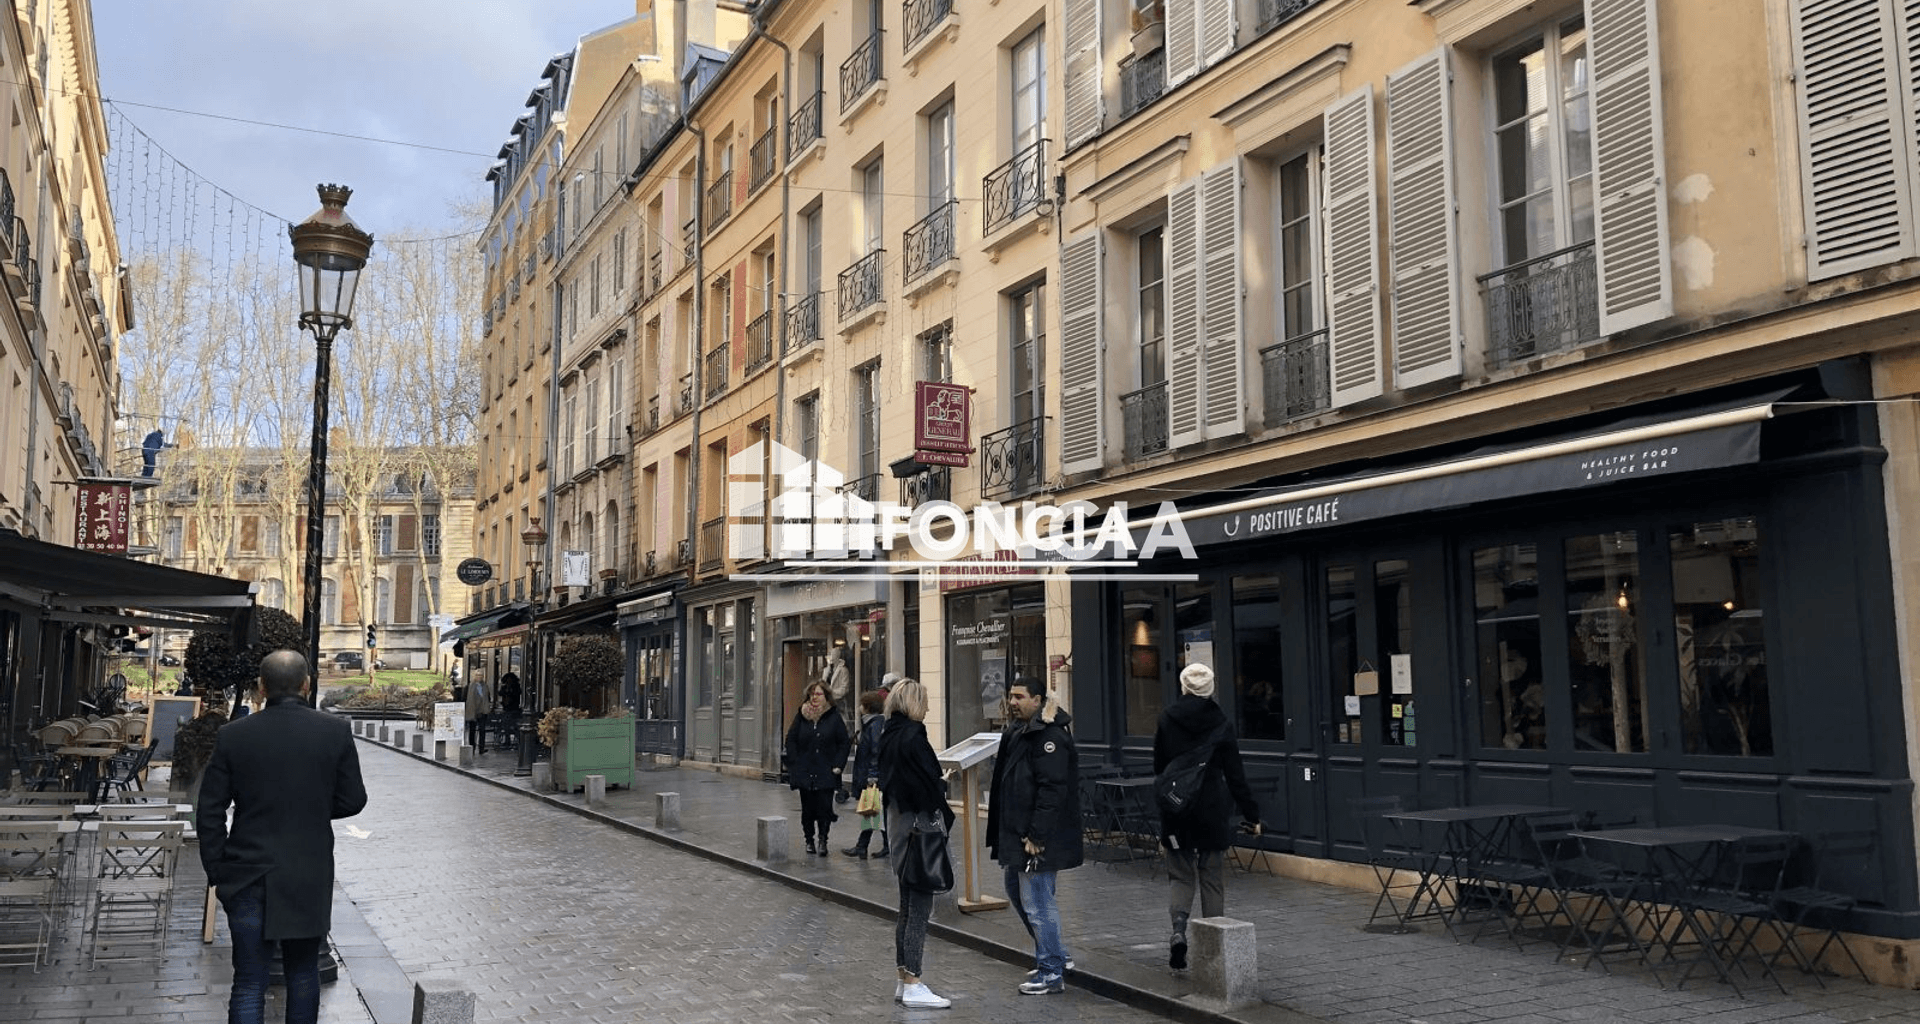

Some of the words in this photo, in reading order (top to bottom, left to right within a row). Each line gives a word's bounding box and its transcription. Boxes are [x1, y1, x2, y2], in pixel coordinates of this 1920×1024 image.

[1581, 454, 1635, 470] HEALTHY
[1643, 447, 1678, 459] FOOD
[1586, 472, 1592, 480] &
[1599, 465, 1635, 478] JUICE
[1643, 460, 1667, 470] BAR
[78, 490, 88, 543] RESTAURANT
[94, 491, 114, 541] 新上海
[117, 492, 127, 534] CHINOIS
[1250, 507, 1303, 532] POSITIVE
[1306, 497, 1339, 524] CAFÉ
